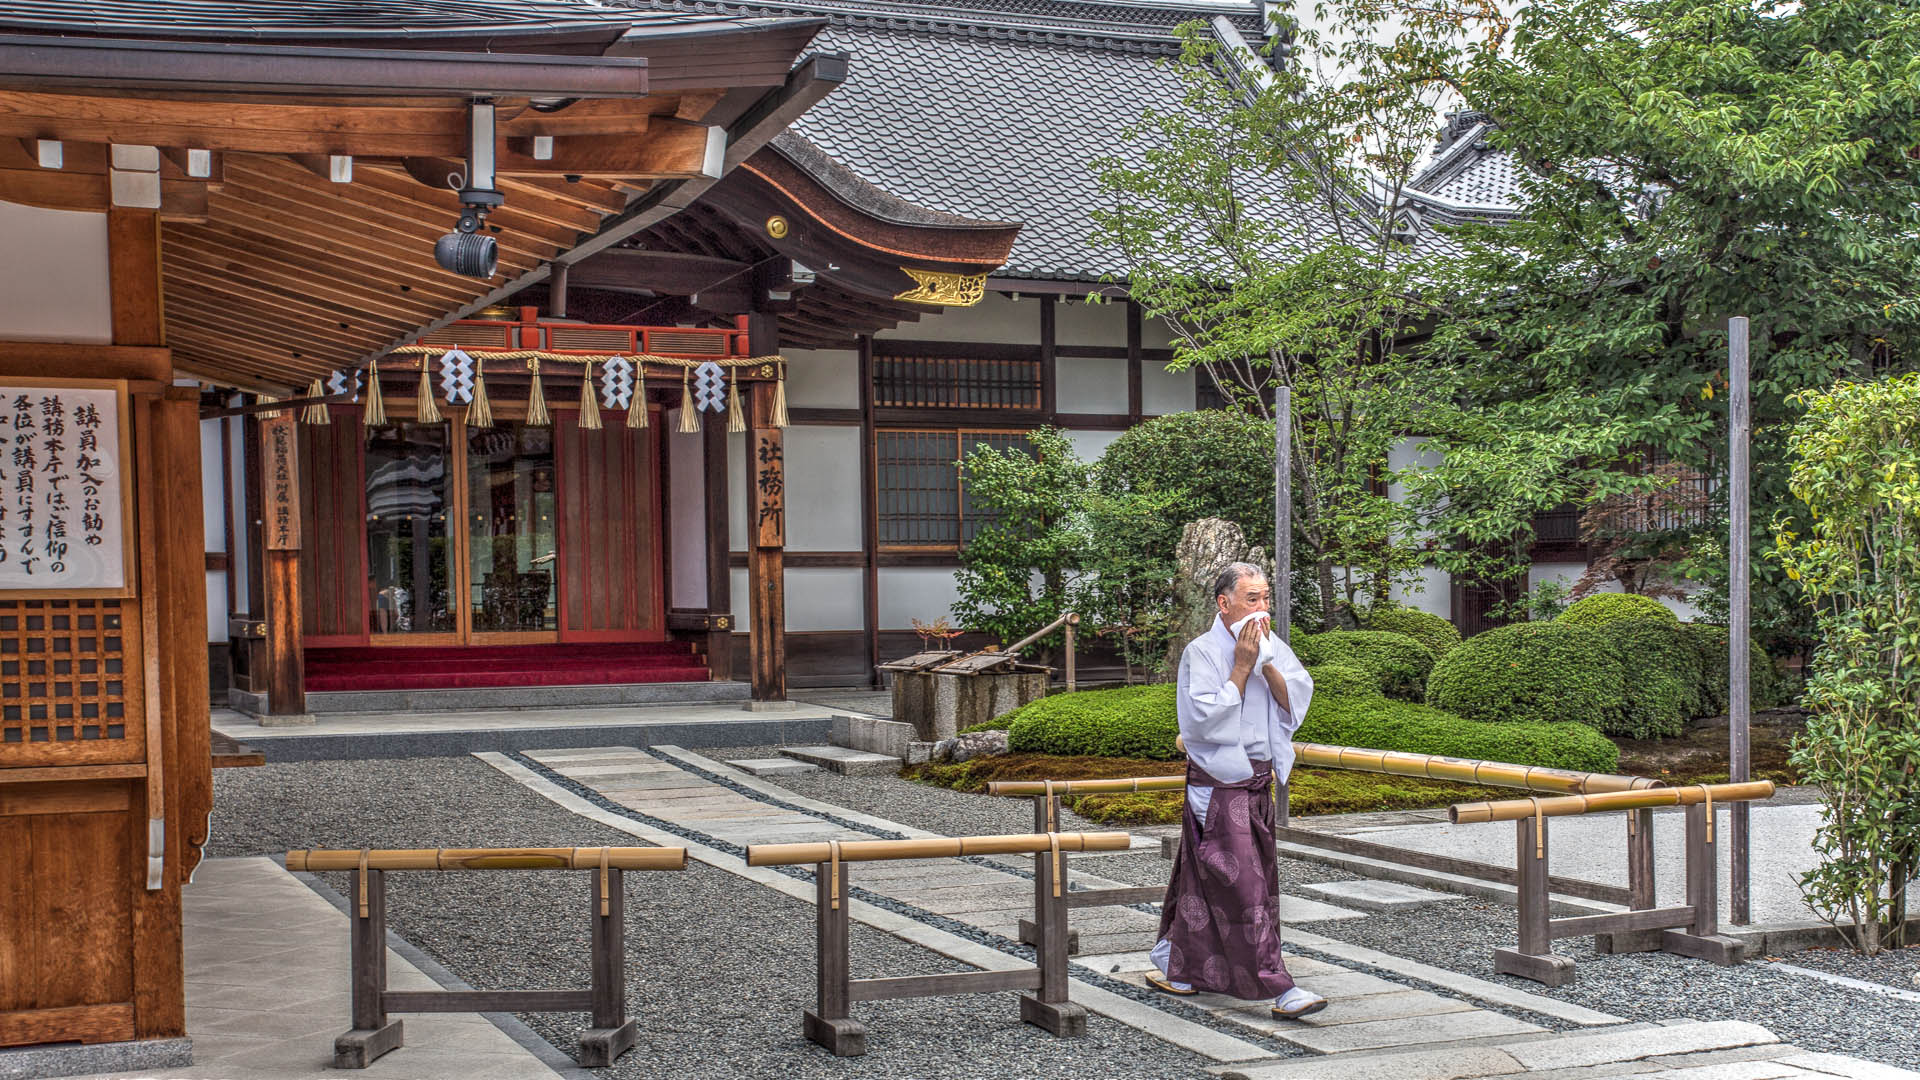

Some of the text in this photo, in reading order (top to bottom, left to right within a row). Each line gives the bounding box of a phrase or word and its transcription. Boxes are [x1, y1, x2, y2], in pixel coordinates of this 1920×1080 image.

[12, 394, 40, 575] 各位が講員にすすんで
[40, 394, 70, 573] 講務本庁ではご信仰の
[72, 403, 104, 546] 講員加入のお勧め
[758, 437, 783, 537] 社務所
